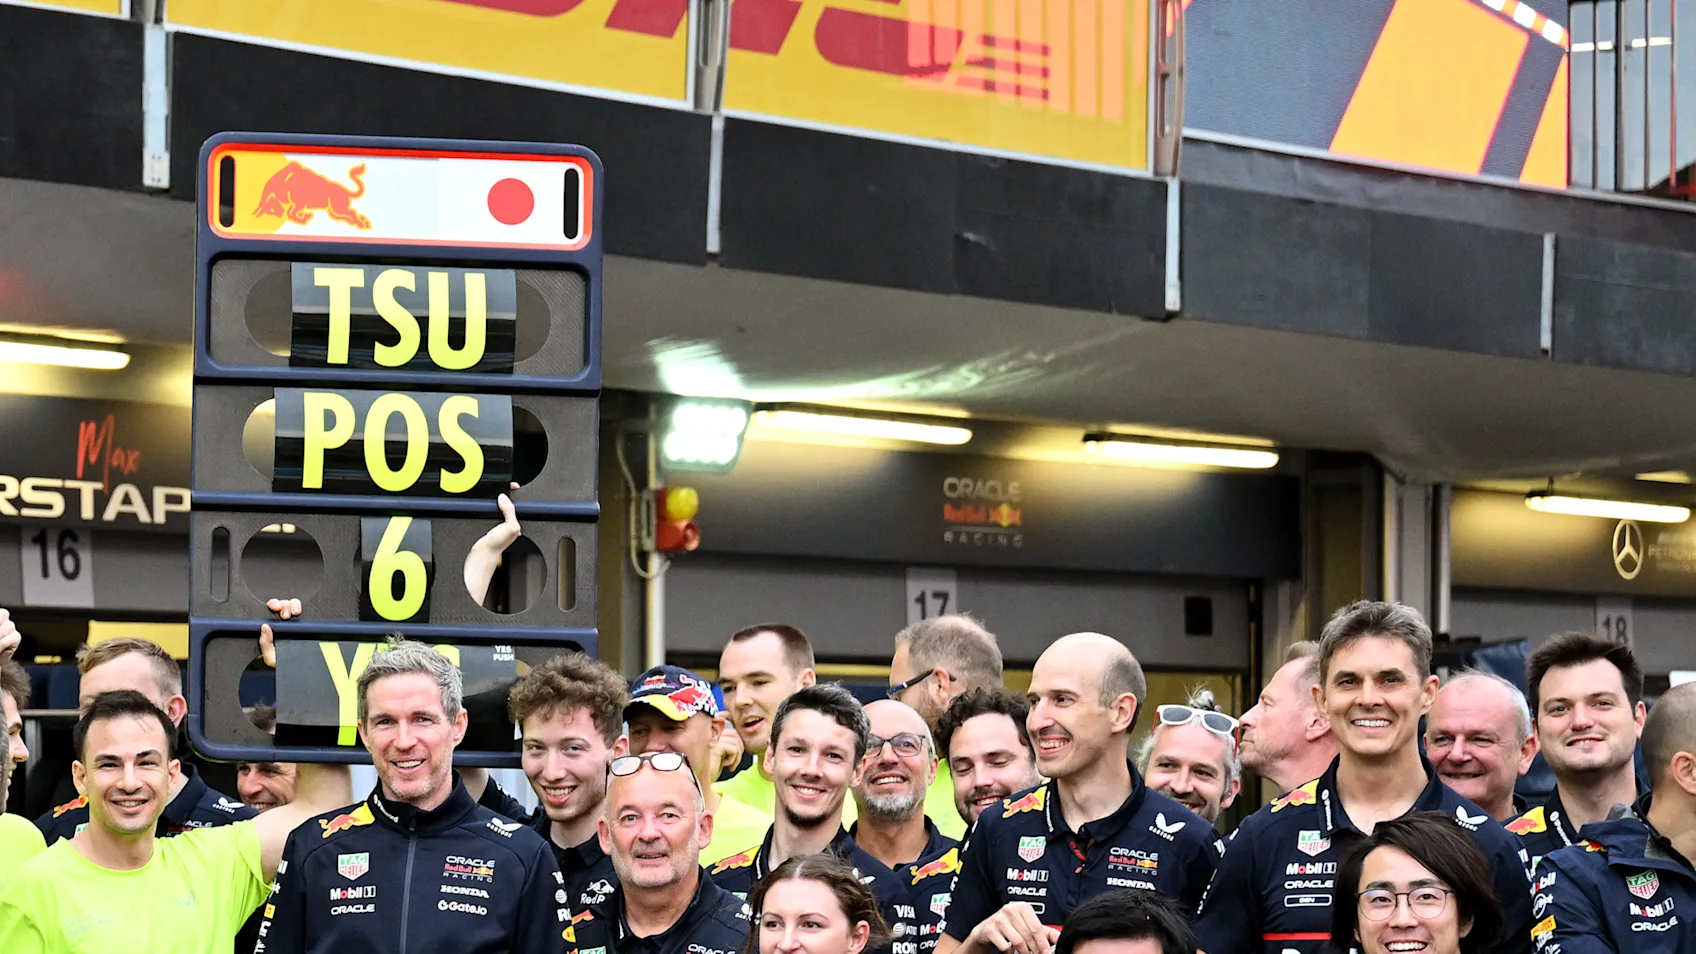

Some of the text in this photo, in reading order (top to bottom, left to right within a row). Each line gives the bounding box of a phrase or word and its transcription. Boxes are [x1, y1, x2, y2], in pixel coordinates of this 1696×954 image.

[313, 268, 486, 370] TSU
[303, 392, 485, 492] POS
[76, 414, 140, 492] Max
[943, 477, 1021, 500] ORACLE
[944, 530, 1022, 548] RACING
[32, 529, 81, 580] 16
[368, 515, 427, 622] 6
[914, 590, 949, 620] 17
[1603, 614, 1627, 647] 18
[1021, 837, 1045, 847] TAG
[340, 854, 366, 865] TAG
[1110, 847, 1158, 860] ORACLE
[445, 855, 495, 868] ORACLE
[1286, 862, 1323, 875] Mobil
[443, 872, 493, 883] RACING
[1007, 869, 1037, 882] Mobil
[1106, 877, 1156, 890] HONDA
[1284, 880, 1334, 889] ORACLE
[330, 887, 363, 900] Mobil
[440, 885, 489, 898] HONDA
[1007, 886, 1047, 896] ORACLE
[330, 904, 375, 915] ORACLE
[448, 900, 488, 916] Gate.io
[893, 905, 915, 919] VISA
[1629, 902, 1663, 917] Mobil
[1631, 917, 1679, 932] ORACLE
